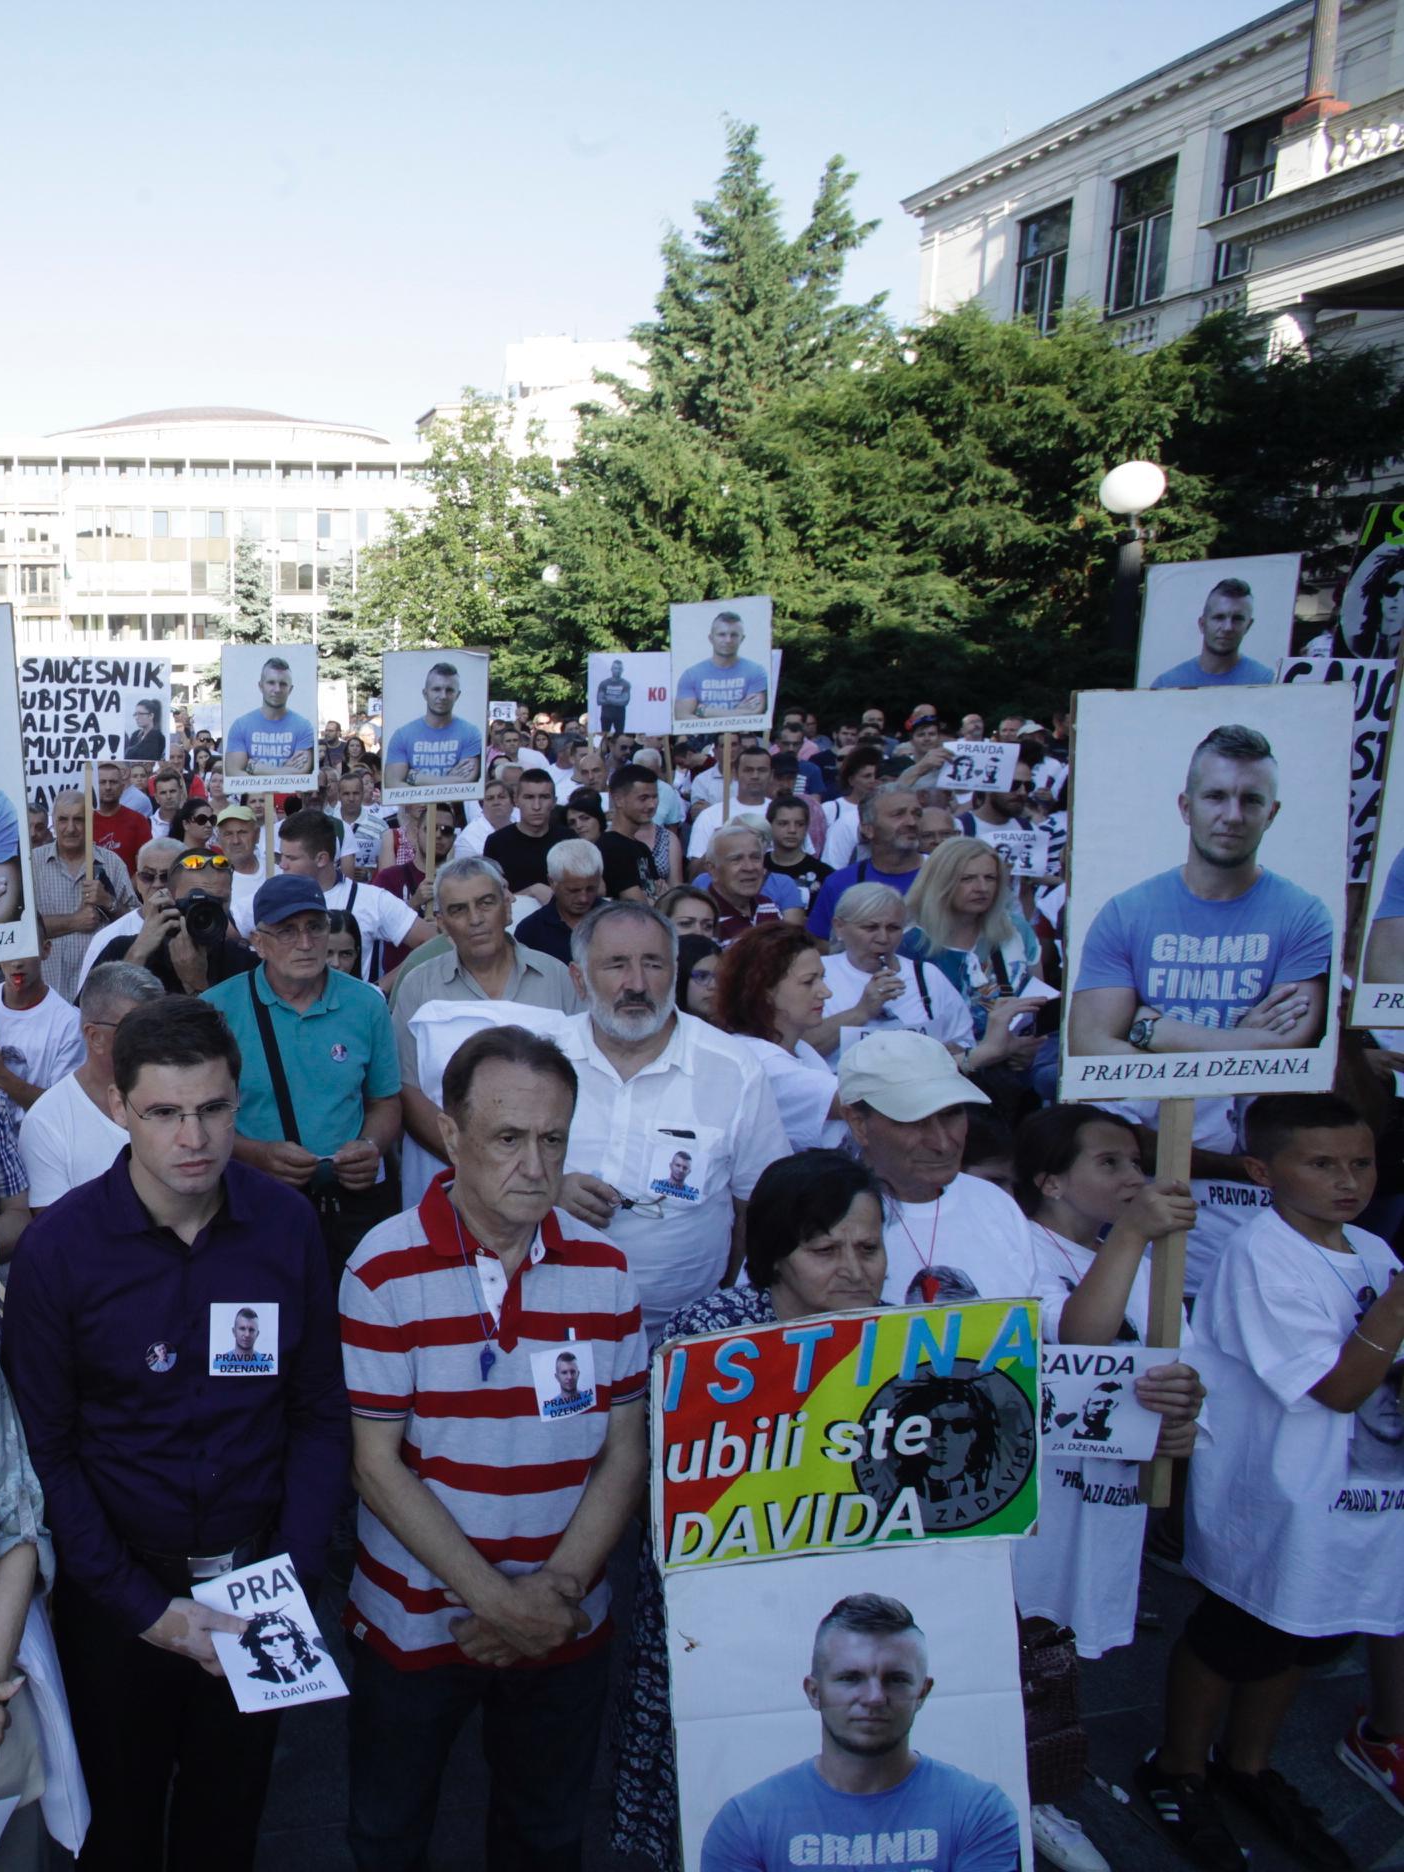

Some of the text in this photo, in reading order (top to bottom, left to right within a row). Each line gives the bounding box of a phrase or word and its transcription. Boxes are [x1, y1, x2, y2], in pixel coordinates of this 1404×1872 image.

[22, 657, 165, 689] SAUČESNIK
[21, 688, 121, 713] UBISTVA
[23, 712, 101, 734] ALISA
[24, 735, 121, 761] MUTAP!
[251, 731, 293, 745] GRAND
[413, 740, 459, 753] GRAND
[250, 744, 292, 757] FINALS
[412, 752, 457, 766] FINALS
[957, 743, 1005, 755] PRAVDA
[230, 778, 262, 787] PRAVDA
[274, 776, 311, 785] DŽENANA
[389, 788, 423, 799] PRAVDA
[993, 832, 1037, 842] PRAVDA
[1151, 933, 1270, 964] GRAND
[1147, 968, 1264, 1000] FINALS
[1079, 1057, 1310, 1082] PRAVDA ZA DŽENANA
[215, 1353, 274, 1362] PRAVDA ZA
[662, 1305, 1038, 1412] ISTINA
[665, 1407, 933, 1483] ubili ste
[1051, 1441, 1124, 1455] ZA DŽENANA
[935, 1506, 968, 1523] ZA
[667, 1487, 926, 1565] DAVIDA
[263, 1680, 328, 1701] ZA DAVIDA
[789, 1828, 939, 1867] GRAND
